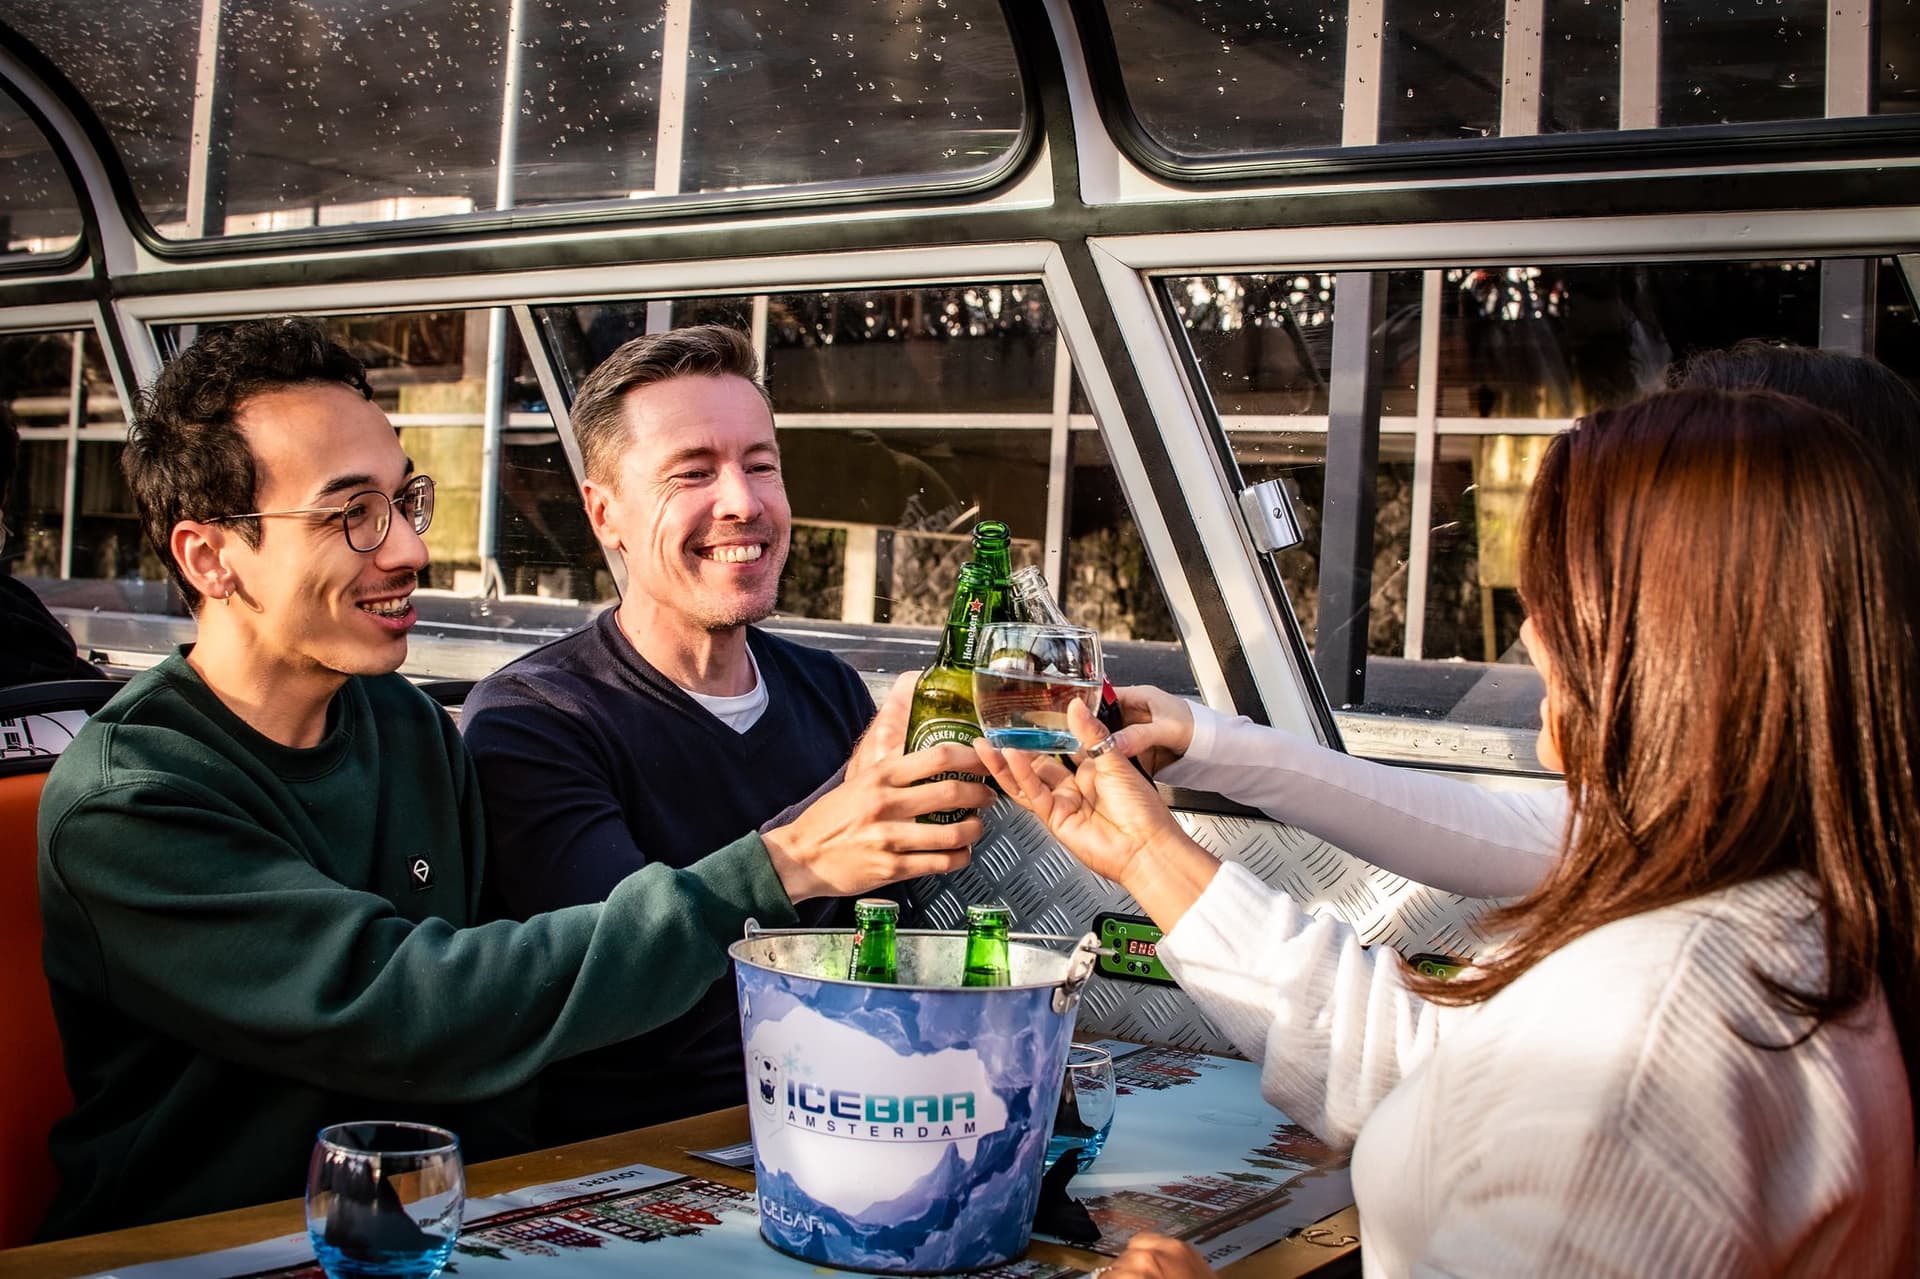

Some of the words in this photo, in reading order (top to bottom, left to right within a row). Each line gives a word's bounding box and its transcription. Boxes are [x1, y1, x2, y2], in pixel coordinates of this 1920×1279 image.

[962, 613, 978, 660] Heineken
[850, 948, 859, 980] neken
[1129, 941, 1156, 957] ENG
[787, 1080, 976, 1124] ICEBAR
[788, 1110, 976, 1138] AMSTERDAM
